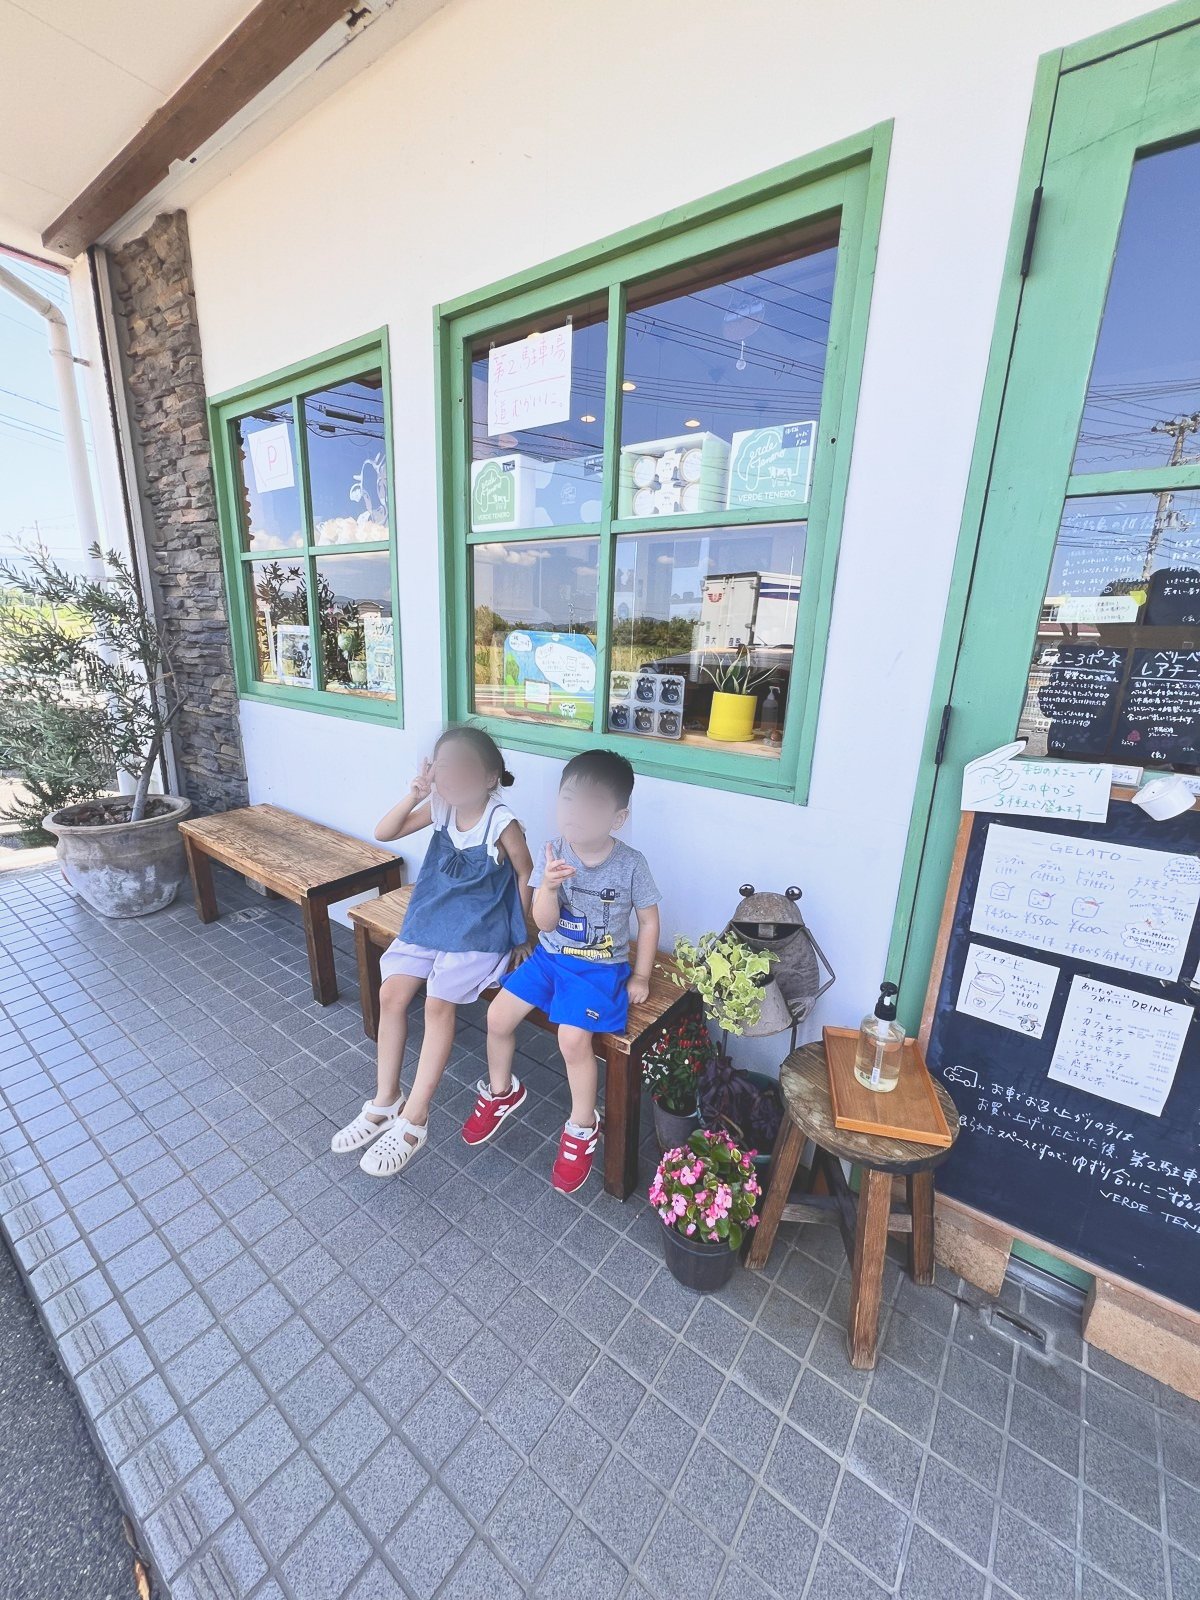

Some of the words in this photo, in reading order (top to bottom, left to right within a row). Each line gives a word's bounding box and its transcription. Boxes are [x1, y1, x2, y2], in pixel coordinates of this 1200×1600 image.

[267, 445, 277, 472] P
[738, 492, 763, 502] VERDE
[765, 489, 796, 499] TENERO
[1141, 662, 1200, 678] レアチー
[1022, 763, 1104, 783] 本日のメニューです
[1050, 843, 1121, 861] GELATO
[1086, 1007, 1121, 1021] コーヒー
[1132, 999, 1173, 1016] DRINK
[1082, 1018, 1124, 1033] カフェラテ
[1129, 1149, 1200, 1186] 第2駐車
[1099, 1189, 1152, 1214] VERDE
